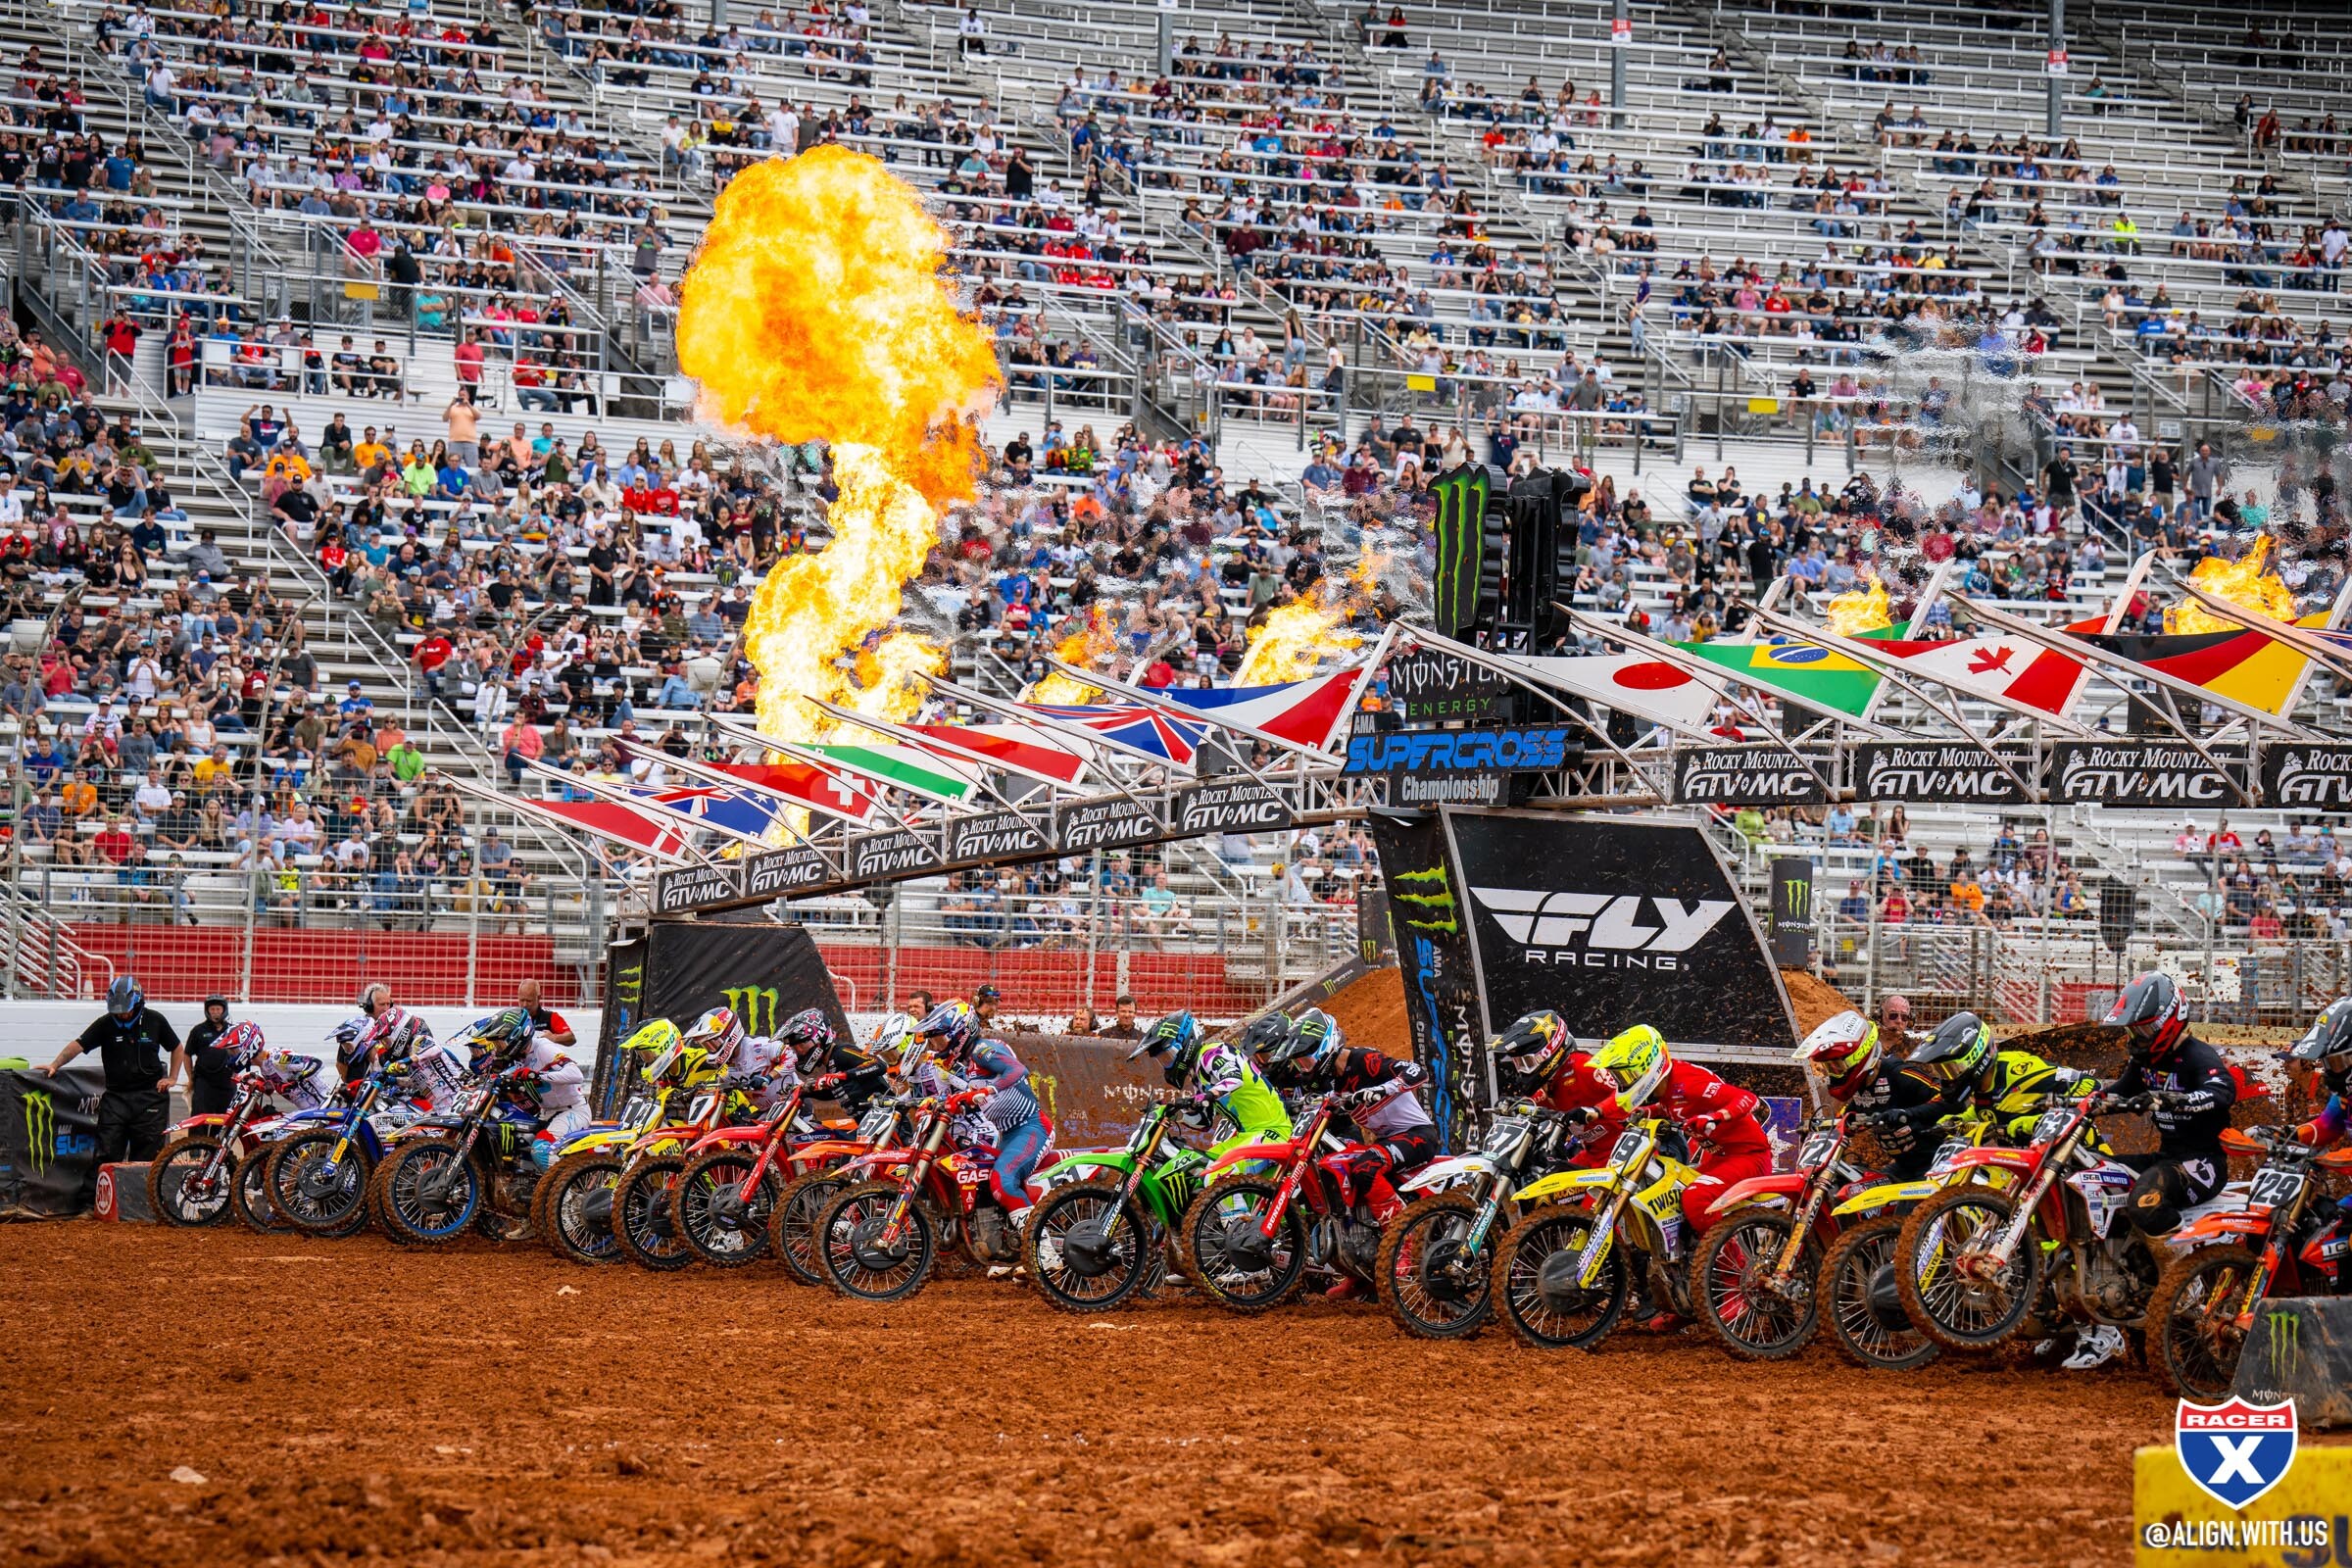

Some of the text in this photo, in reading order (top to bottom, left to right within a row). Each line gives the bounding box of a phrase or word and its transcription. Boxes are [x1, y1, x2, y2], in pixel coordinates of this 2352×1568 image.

[1409, 697, 1491, 716] ENERGY
[1354, 713, 1375, 734] AMA
[1345, 729, 1568, 772] SUPERCROSS
[1702, 748, 1742, 764] ROCKY
[1890, 748, 1937, 766] ROCKY
[2088, 747, 2139, 768] ROCKY
[2305, 749, 2352, 771] ROCK
[1199, 789, 1229, 806] ROCKY
[1401, 772, 1499, 807] Championship
[1080, 807, 1108, 823] ROCKY
[969, 818, 996, 835] ROCKY
[870, 836, 893, 853] ROCKY
[762, 851, 785, 870] ROCKY
[673, 869, 696, 887] ROCKY
[1469, 886, 1738, 953] FLY
[1432, 945, 1443, 979] AMA
[1525, 949, 1678, 970] RACING
[1540, 1048, 1566, 1077] ROCKSTAR
[689, 1098, 710, 1122] 1
[1484, 1126, 1521, 1152] 27
[1899, 1188, 1933, 1197] PROGRESSIVE
[2256, 1173, 2299, 1205] 129
[1102, 1199, 1123, 1238] DUNLOP
[1266, 1190, 1287, 1232] DUNLOP
[1477, 1203, 1496, 1239] MOTOREX
[1593, 1241, 1610, 1267] GALFER
